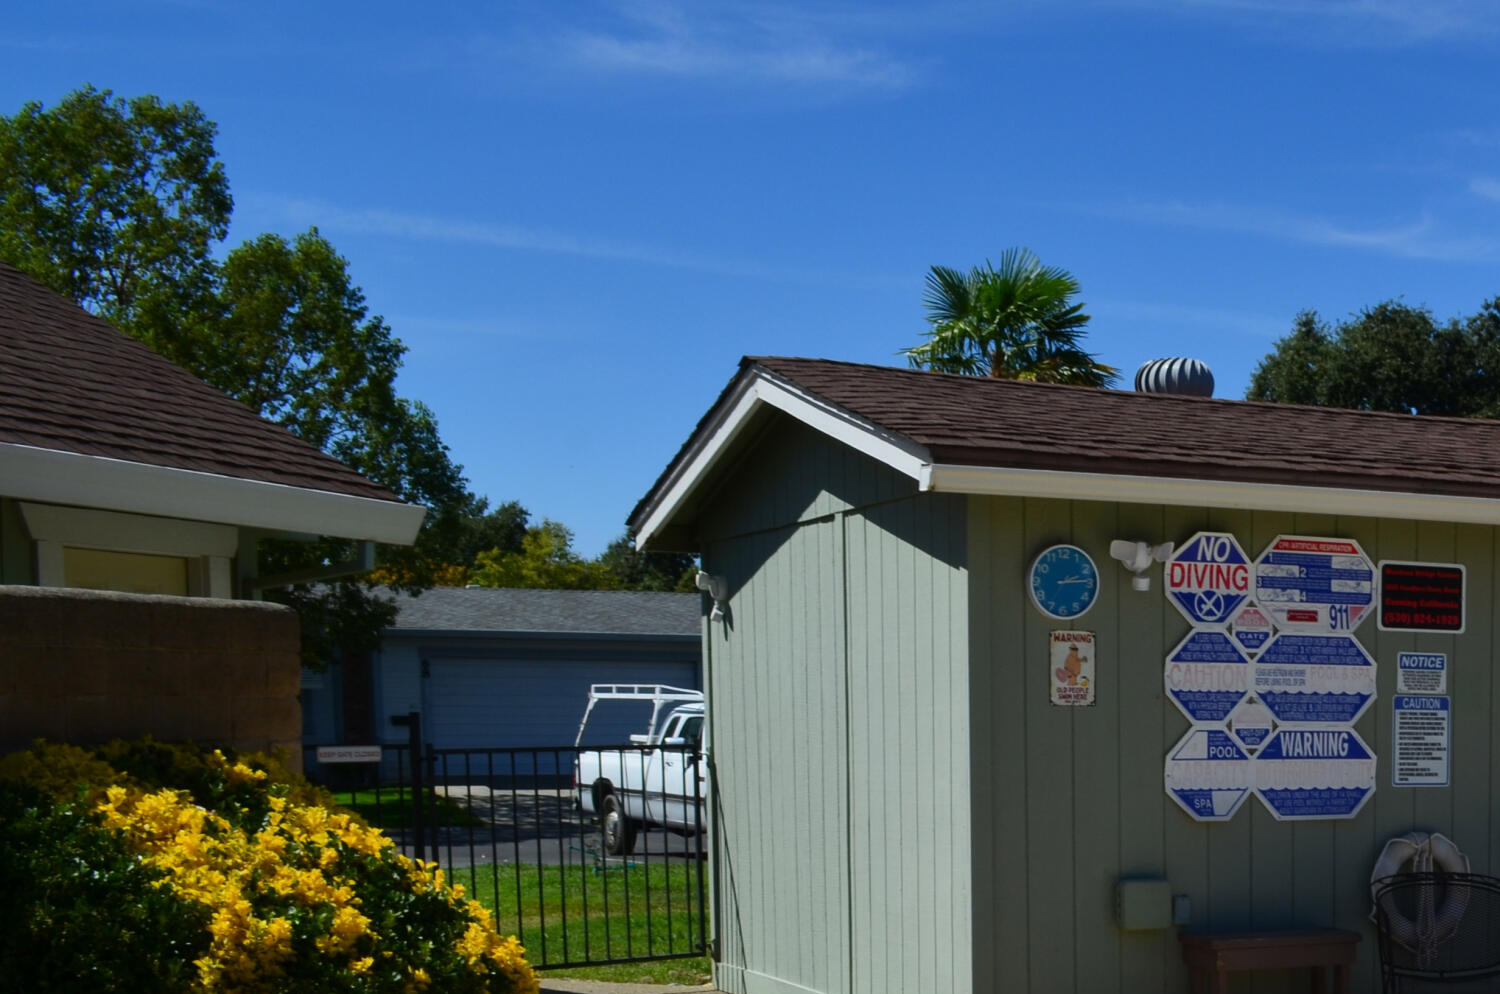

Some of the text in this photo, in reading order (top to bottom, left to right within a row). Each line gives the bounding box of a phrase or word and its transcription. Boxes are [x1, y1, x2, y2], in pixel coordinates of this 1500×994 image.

[1058, 549, 1070, 559] 12
[1197, 536, 1230, 562] NO
[1047, 553, 1056, 562] 11
[1074, 553, 1079, 563] 1
[1037, 563, 1049, 573] 10
[1082, 563, 1089, 574] 2
[1300, 567, 1307, 578] 2
[1170, 562, 1248, 591] DIVING
[1087, 578, 1094, 588] 3
[1037, 590, 1045, 600] 8
[1080, 592, 1088, 600] 4
[1300, 591, 1306, 601] 4
[1047, 601, 1056, 611] 7
[1059, 606, 1067, 615] 6
[1072, 602, 1080, 611] 5
[1329, 604, 1349, 630] 911
[1053, 632, 1092, 643] WARNING
[1239, 632, 1265, 640] GATE
[1401, 655, 1443, 668] NOTICE
[1170, 663, 1248, 689] CAUTION
[1402, 698, 1441, 708] CAUTION
[1279, 731, 1349, 757] WARNING
[1209, 746, 1239, 758] POOL
[1194, 798, 1212, 809] SPA
